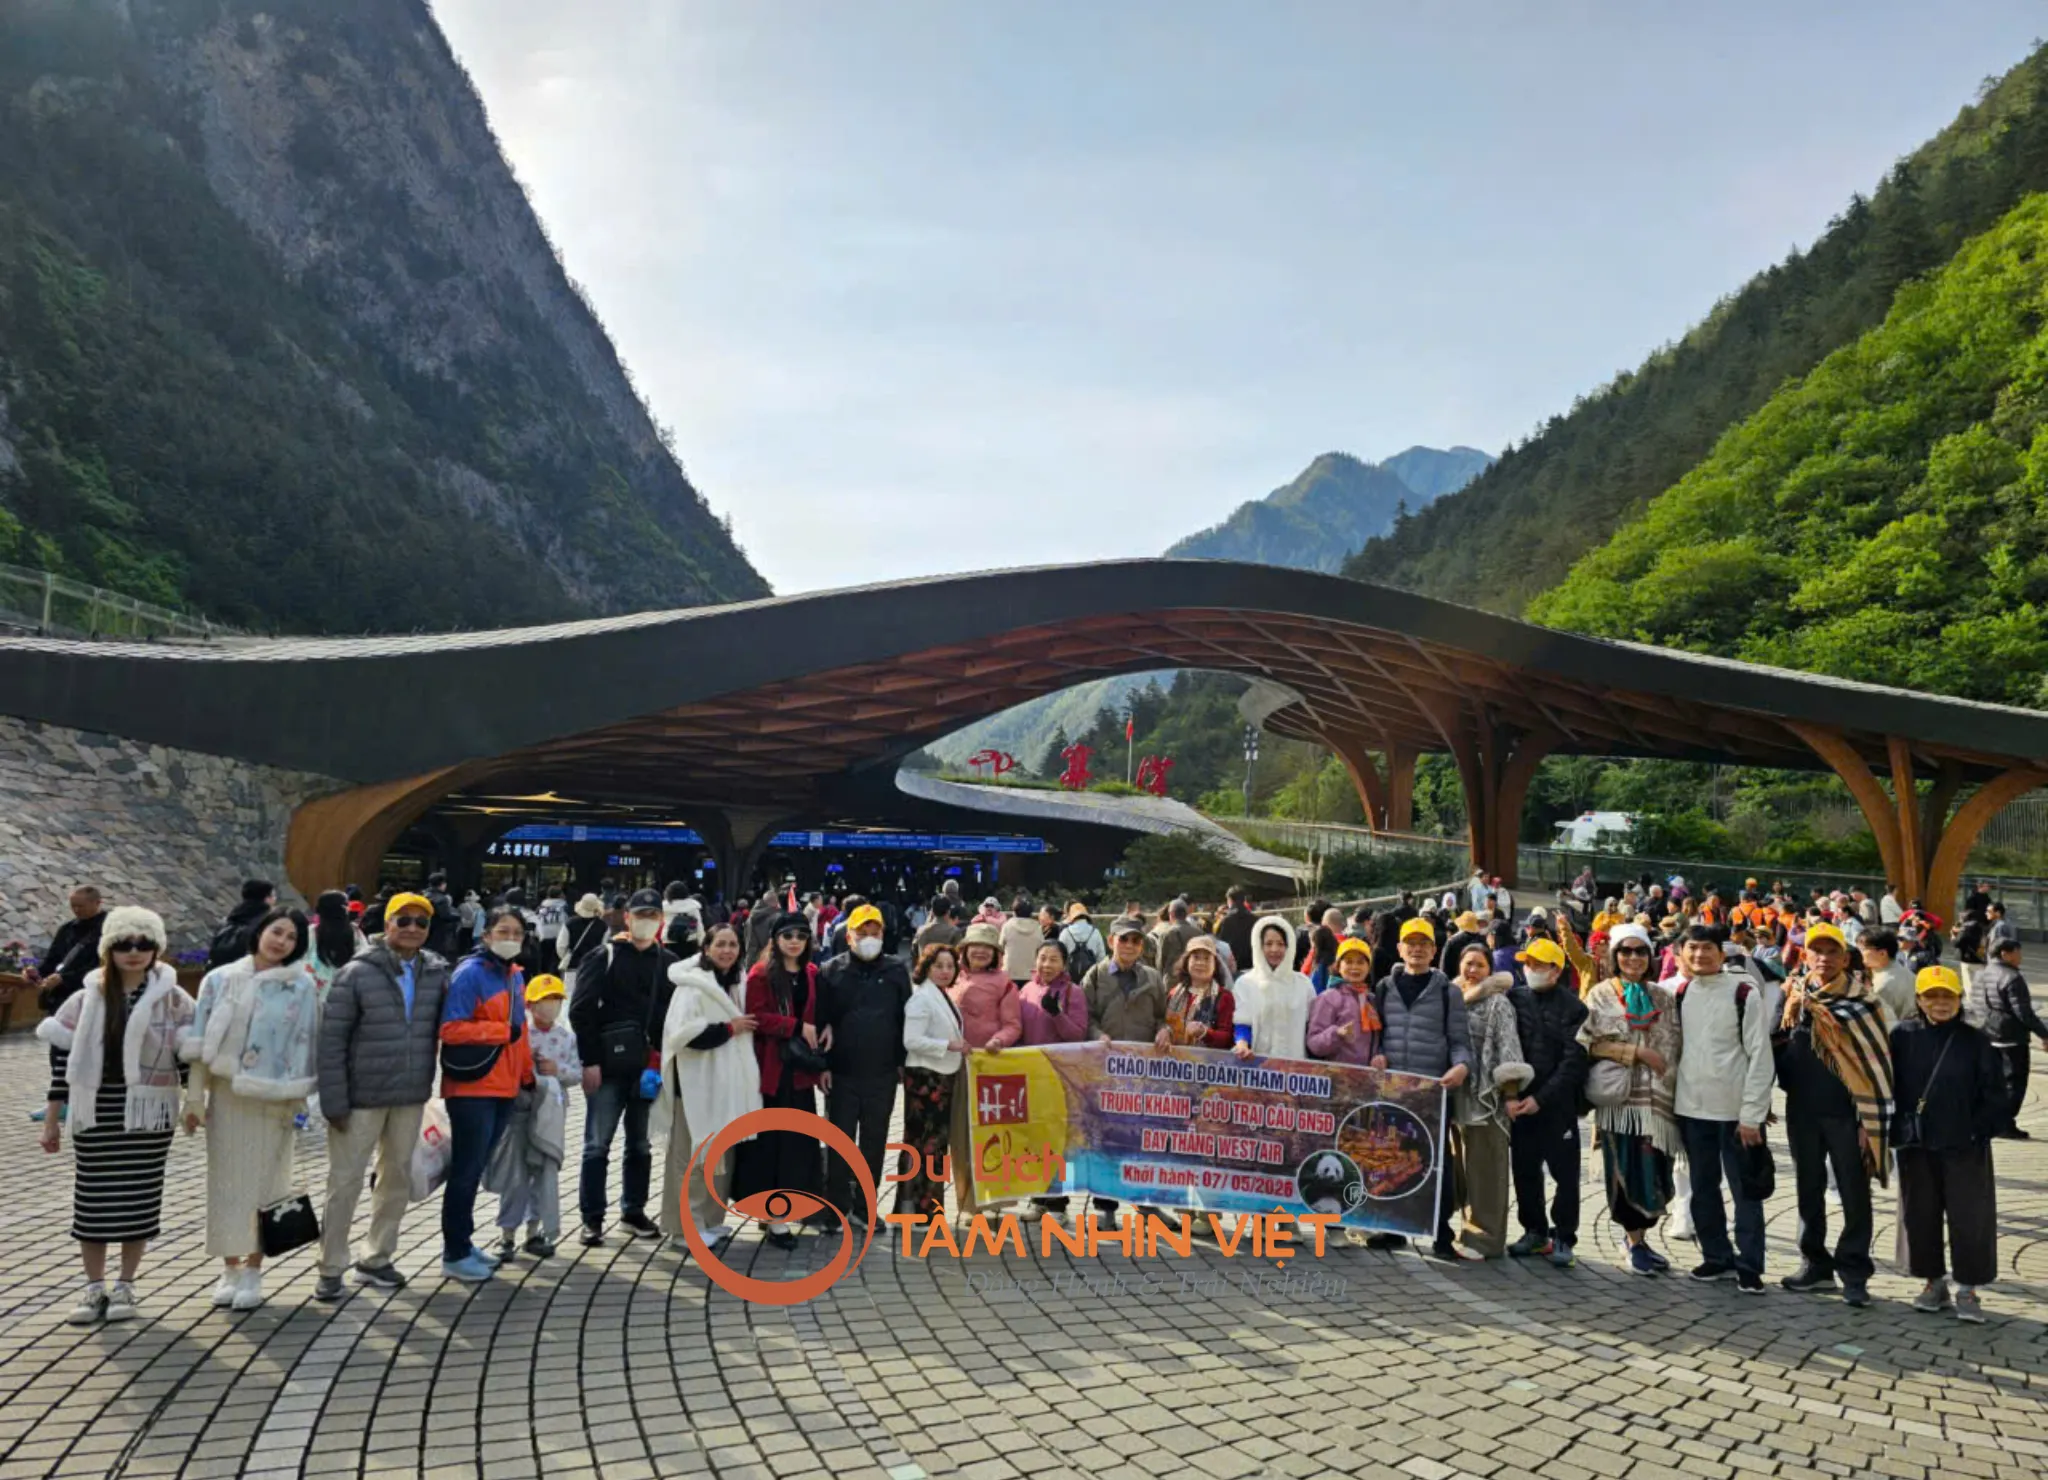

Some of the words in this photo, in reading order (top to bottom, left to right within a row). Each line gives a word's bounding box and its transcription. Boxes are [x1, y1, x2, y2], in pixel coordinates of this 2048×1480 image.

[1107, 1055, 1145, 1076] CHÀO
[1150, 1057, 1193, 1081] MỪNG
[1197, 1061, 1238, 1085] ĐOÀN
[1242, 1070, 1283, 1090] THAM
[1288, 1075, 1330, 1096] QUAN
[978, 1083, 1026, 1123] Hi!
[1145, 1091, 1190, 1117] KHÁNH
[1234, 1103, 1263, 1128] TRẠI
[1143, 1129, 1168, 1151] BAY
[1218, 1135, 1258, 1159] WEST
[1259, 1141, 1283, 1163] AIR
[1123, 1164, 1155, 1183] Khởi
[1158, 1167, 1199, 1187] hành:
[1202, 1171, 1228, 1190] 07/
